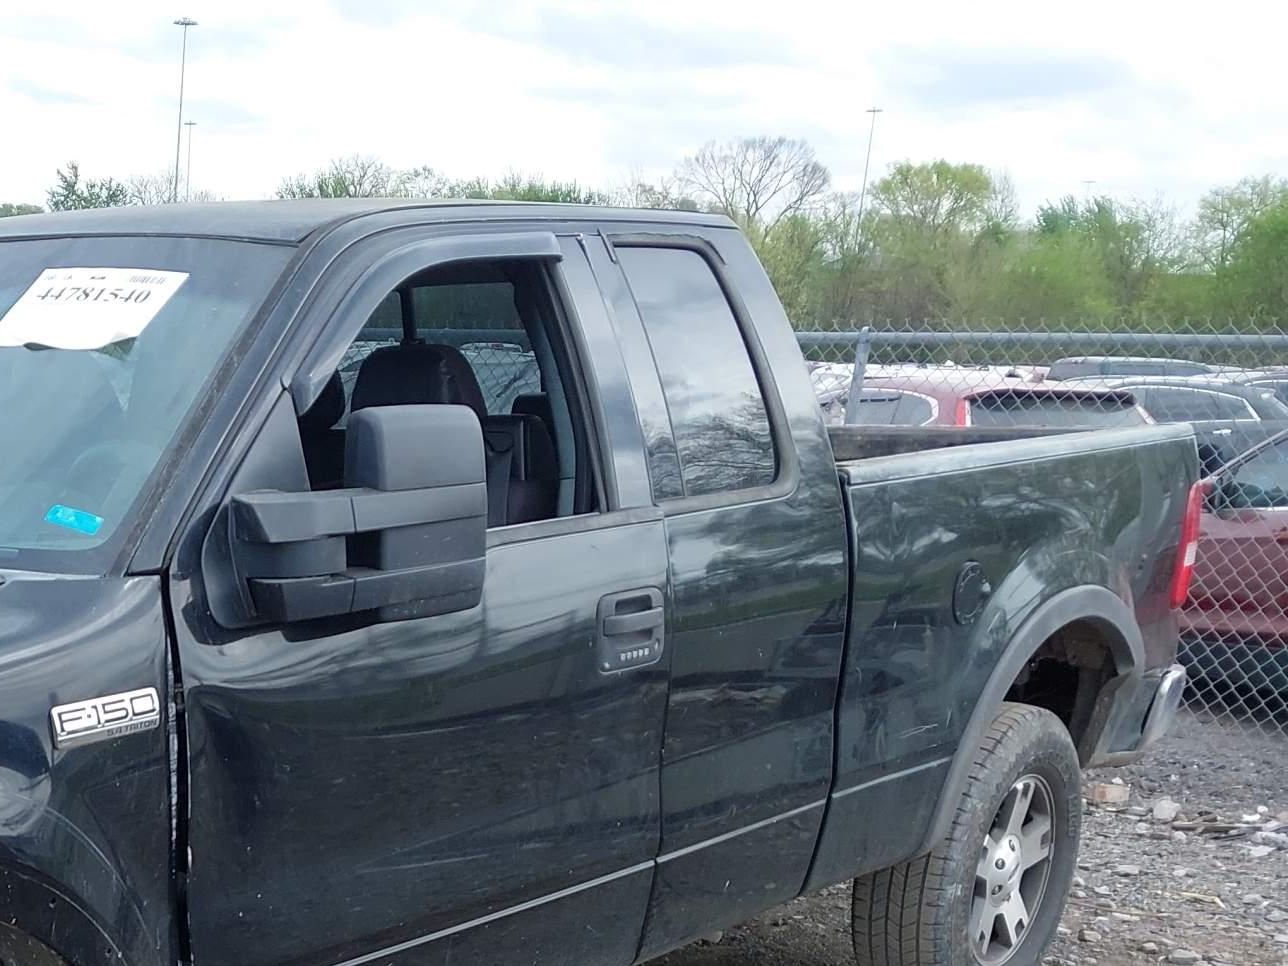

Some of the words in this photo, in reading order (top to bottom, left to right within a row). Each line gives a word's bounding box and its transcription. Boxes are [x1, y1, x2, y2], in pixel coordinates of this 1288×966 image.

[36, 286, 152, 304] 44781540
[55, 691, 158, 735] F-150
[123, 717, 159, 733] TRITON
